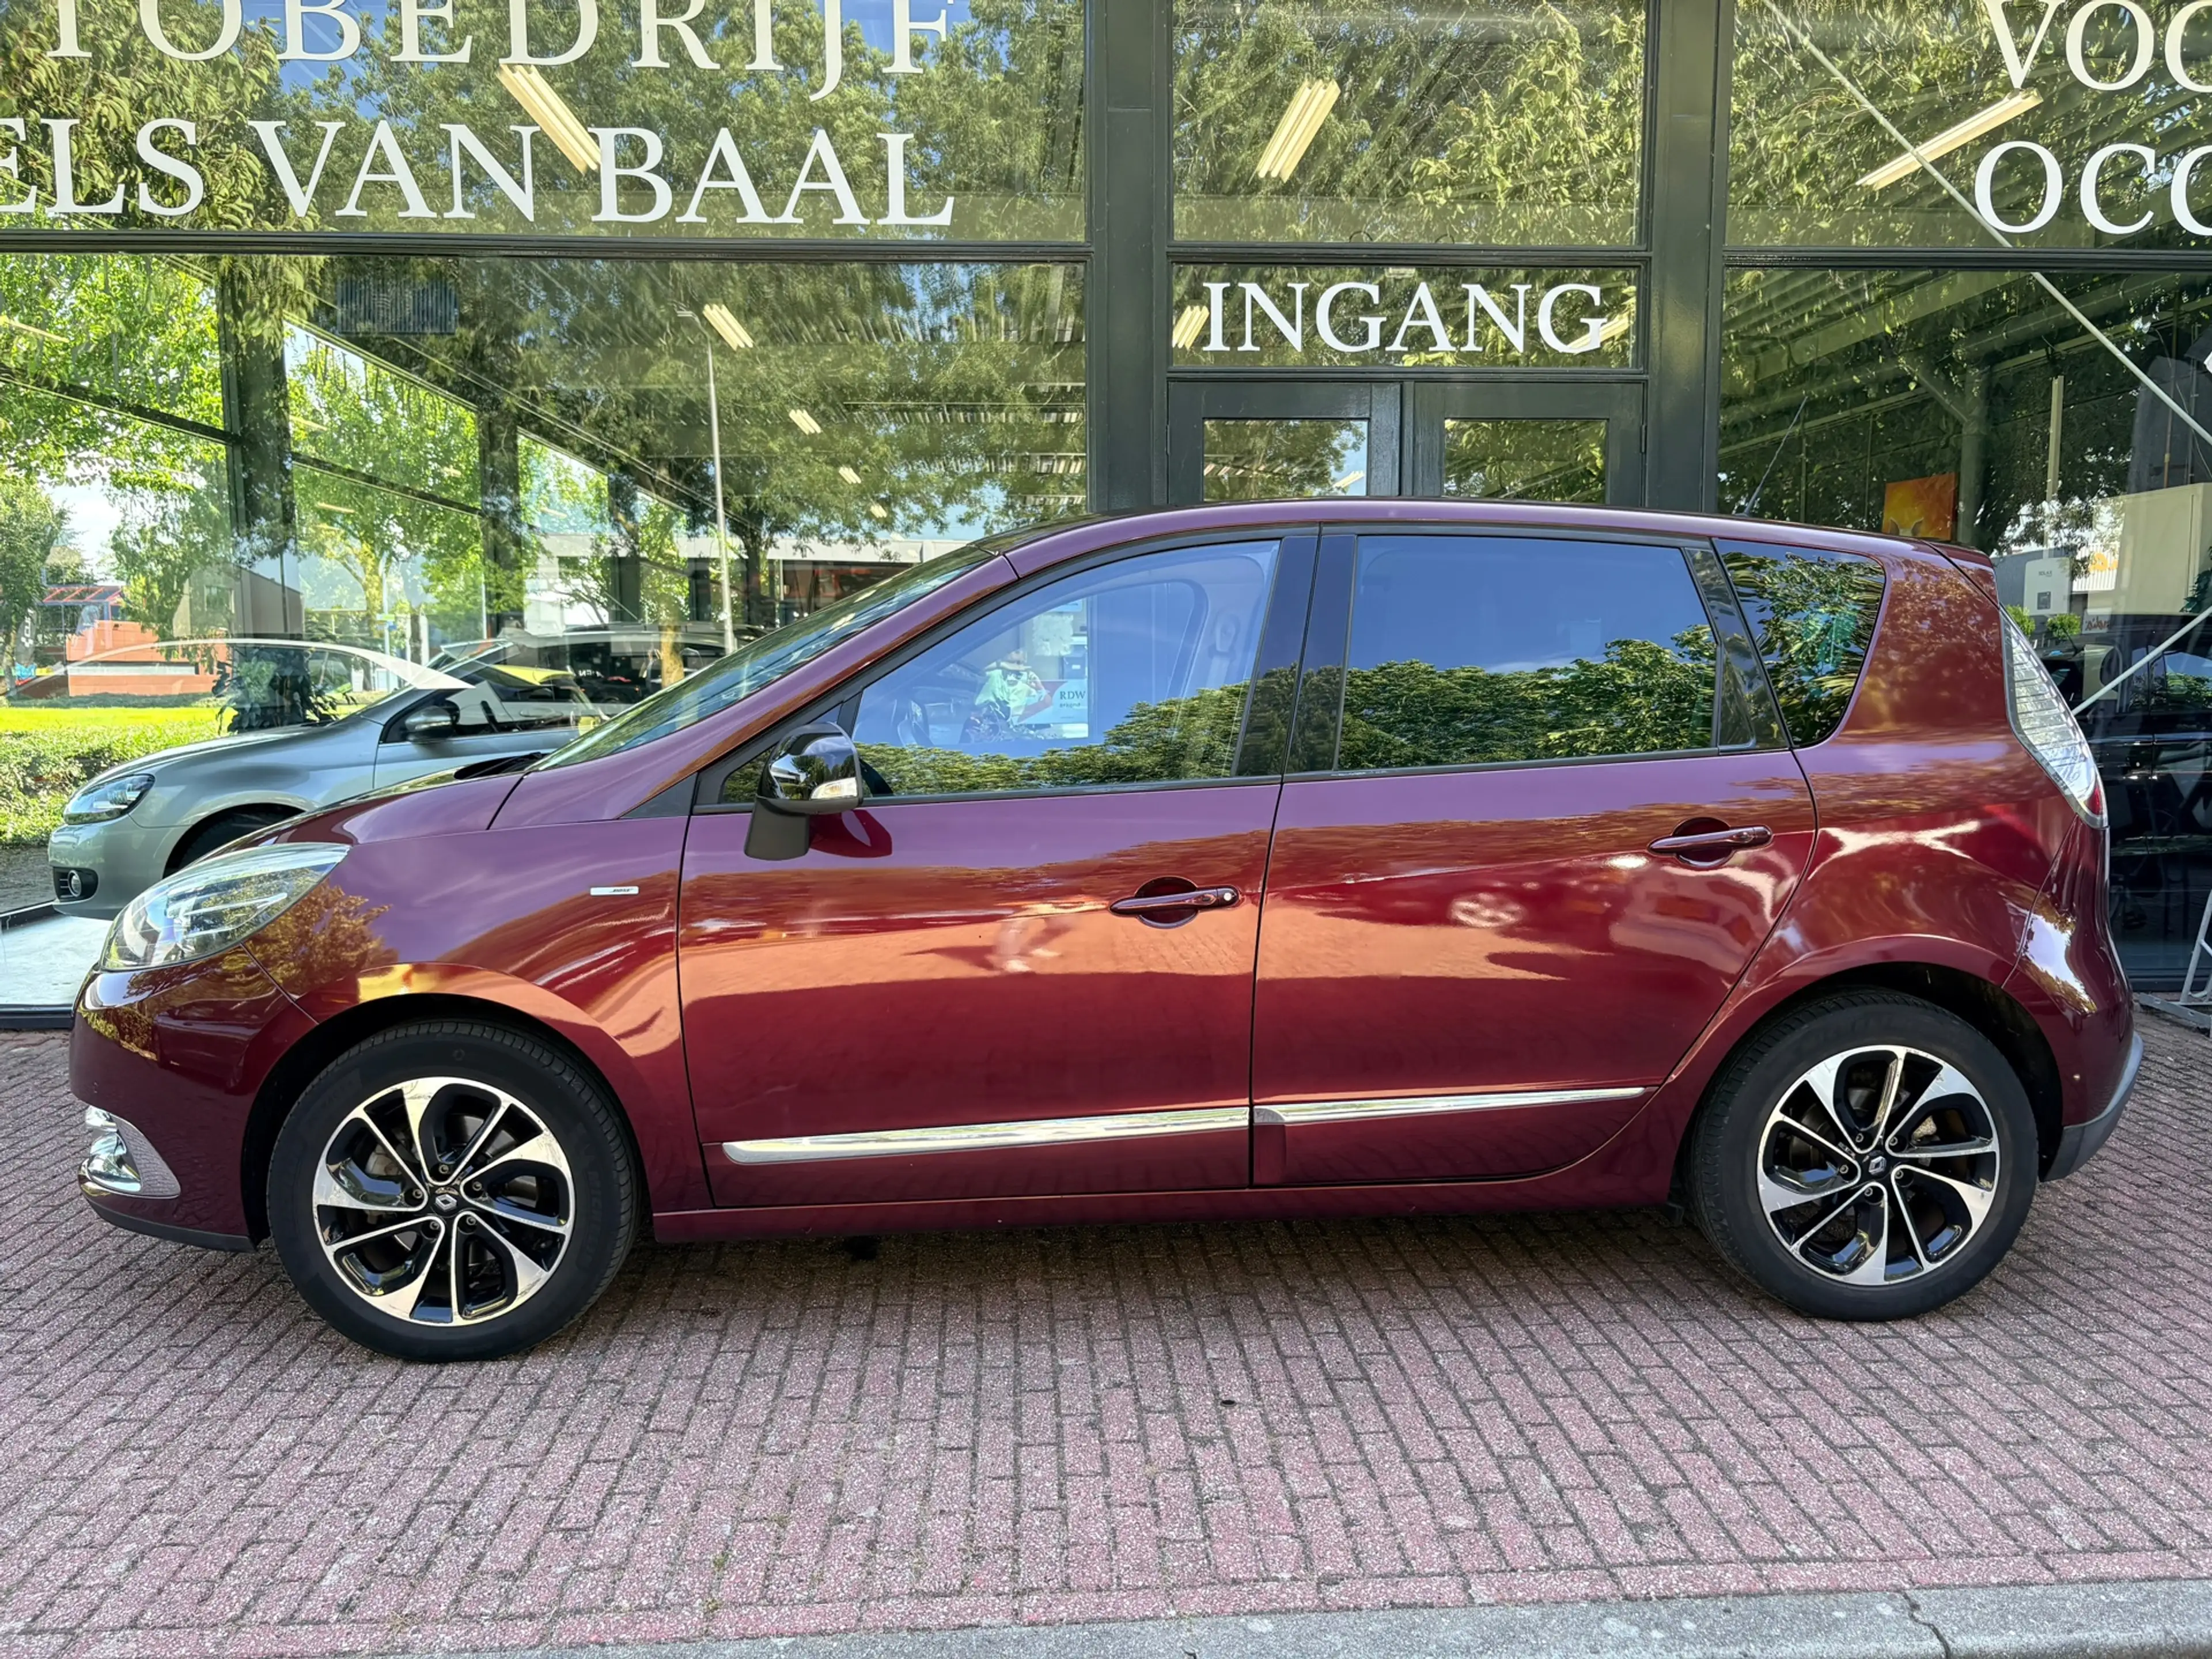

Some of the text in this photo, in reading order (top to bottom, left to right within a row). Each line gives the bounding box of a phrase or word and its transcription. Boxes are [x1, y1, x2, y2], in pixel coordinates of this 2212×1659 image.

[248, 119, 541, 222] VAN
[588, 127, 955, 226] BAAL
[1202, 281, 1608, 353] INGANG
[1060, 691, 1086, 700] RDW
